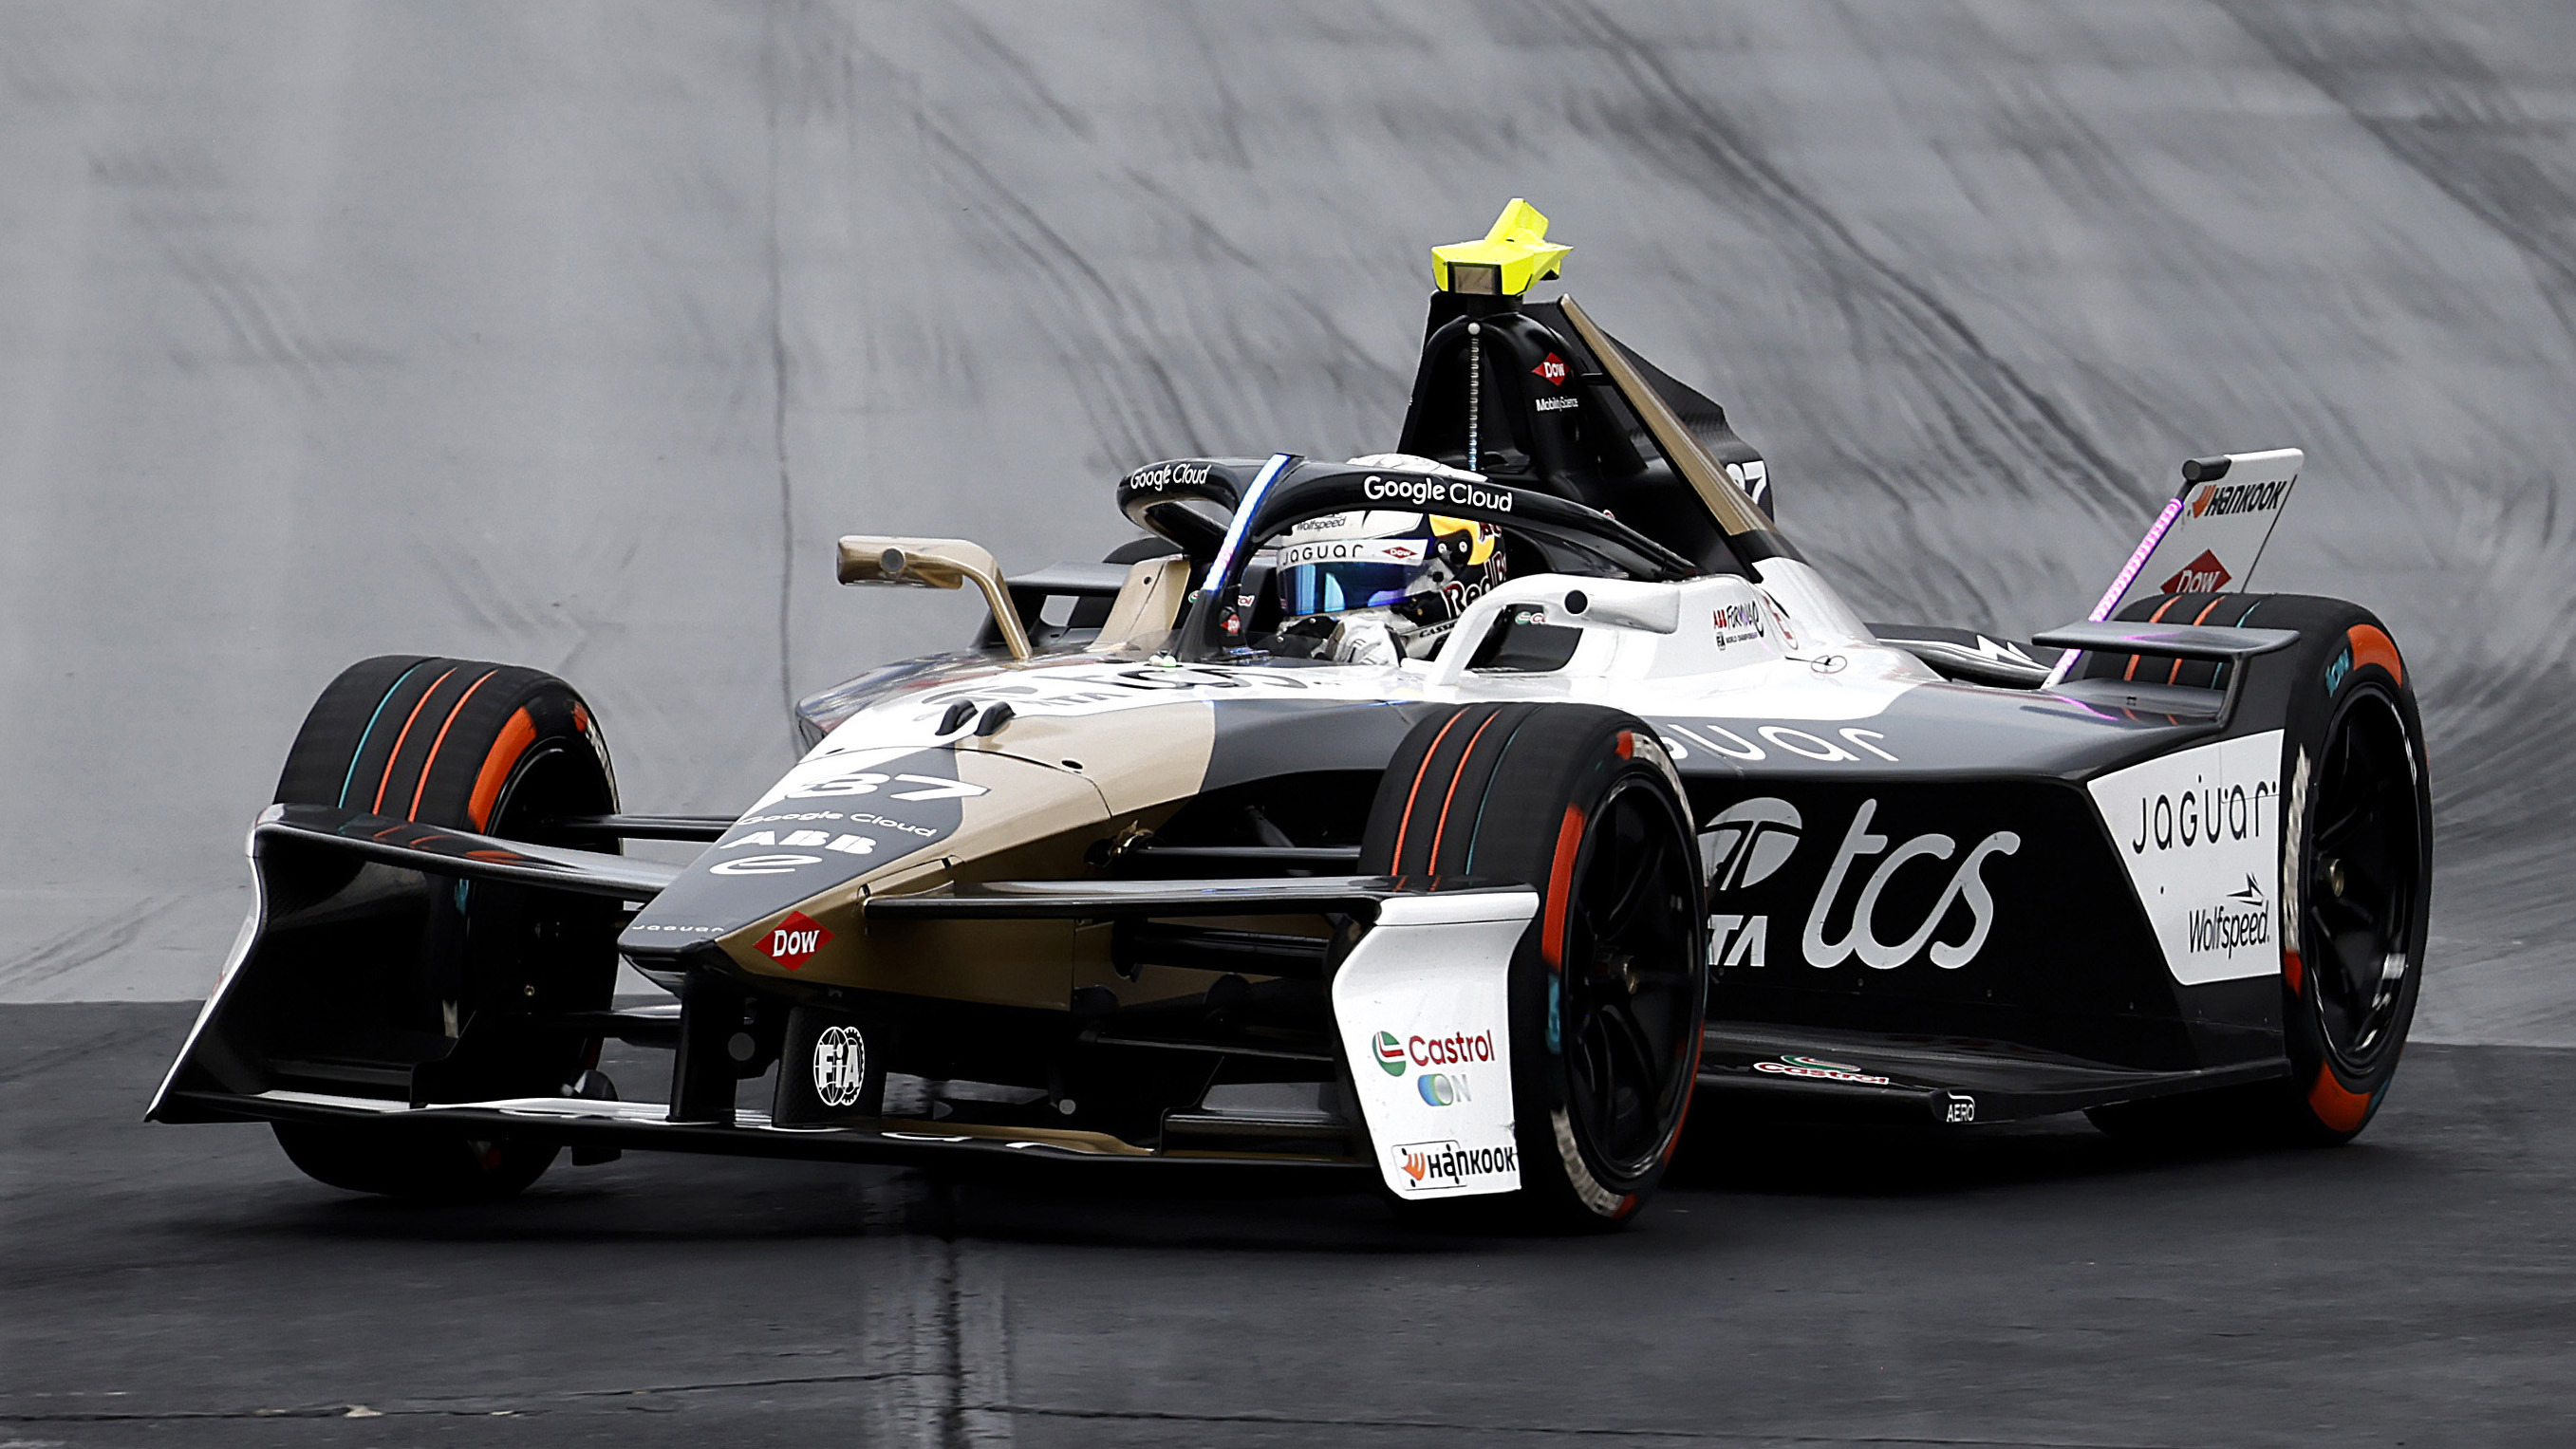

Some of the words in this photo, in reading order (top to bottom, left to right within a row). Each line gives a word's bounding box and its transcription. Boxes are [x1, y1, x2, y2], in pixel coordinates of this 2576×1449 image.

[1130, 464, 1171, 492] Google
[1173, 463, 1212, 485] Cloud
[1364, 475, 1446, 505] Google
[1449, 483, 1513, 512] Cloud
[737, 810, 844, 827] Google
[850, 813, 938, 838] Cloud
[719, 829, 877, 855] ABB
[1802, 798, 2021, 970] tcs
[772, 928, 819, 957] DOW
[1409, 1029, 1496, 1067] Castrol
[1753, 1061, 1890, 1086] Castrol
[1946, 1103, 1975, 1123] AERO
